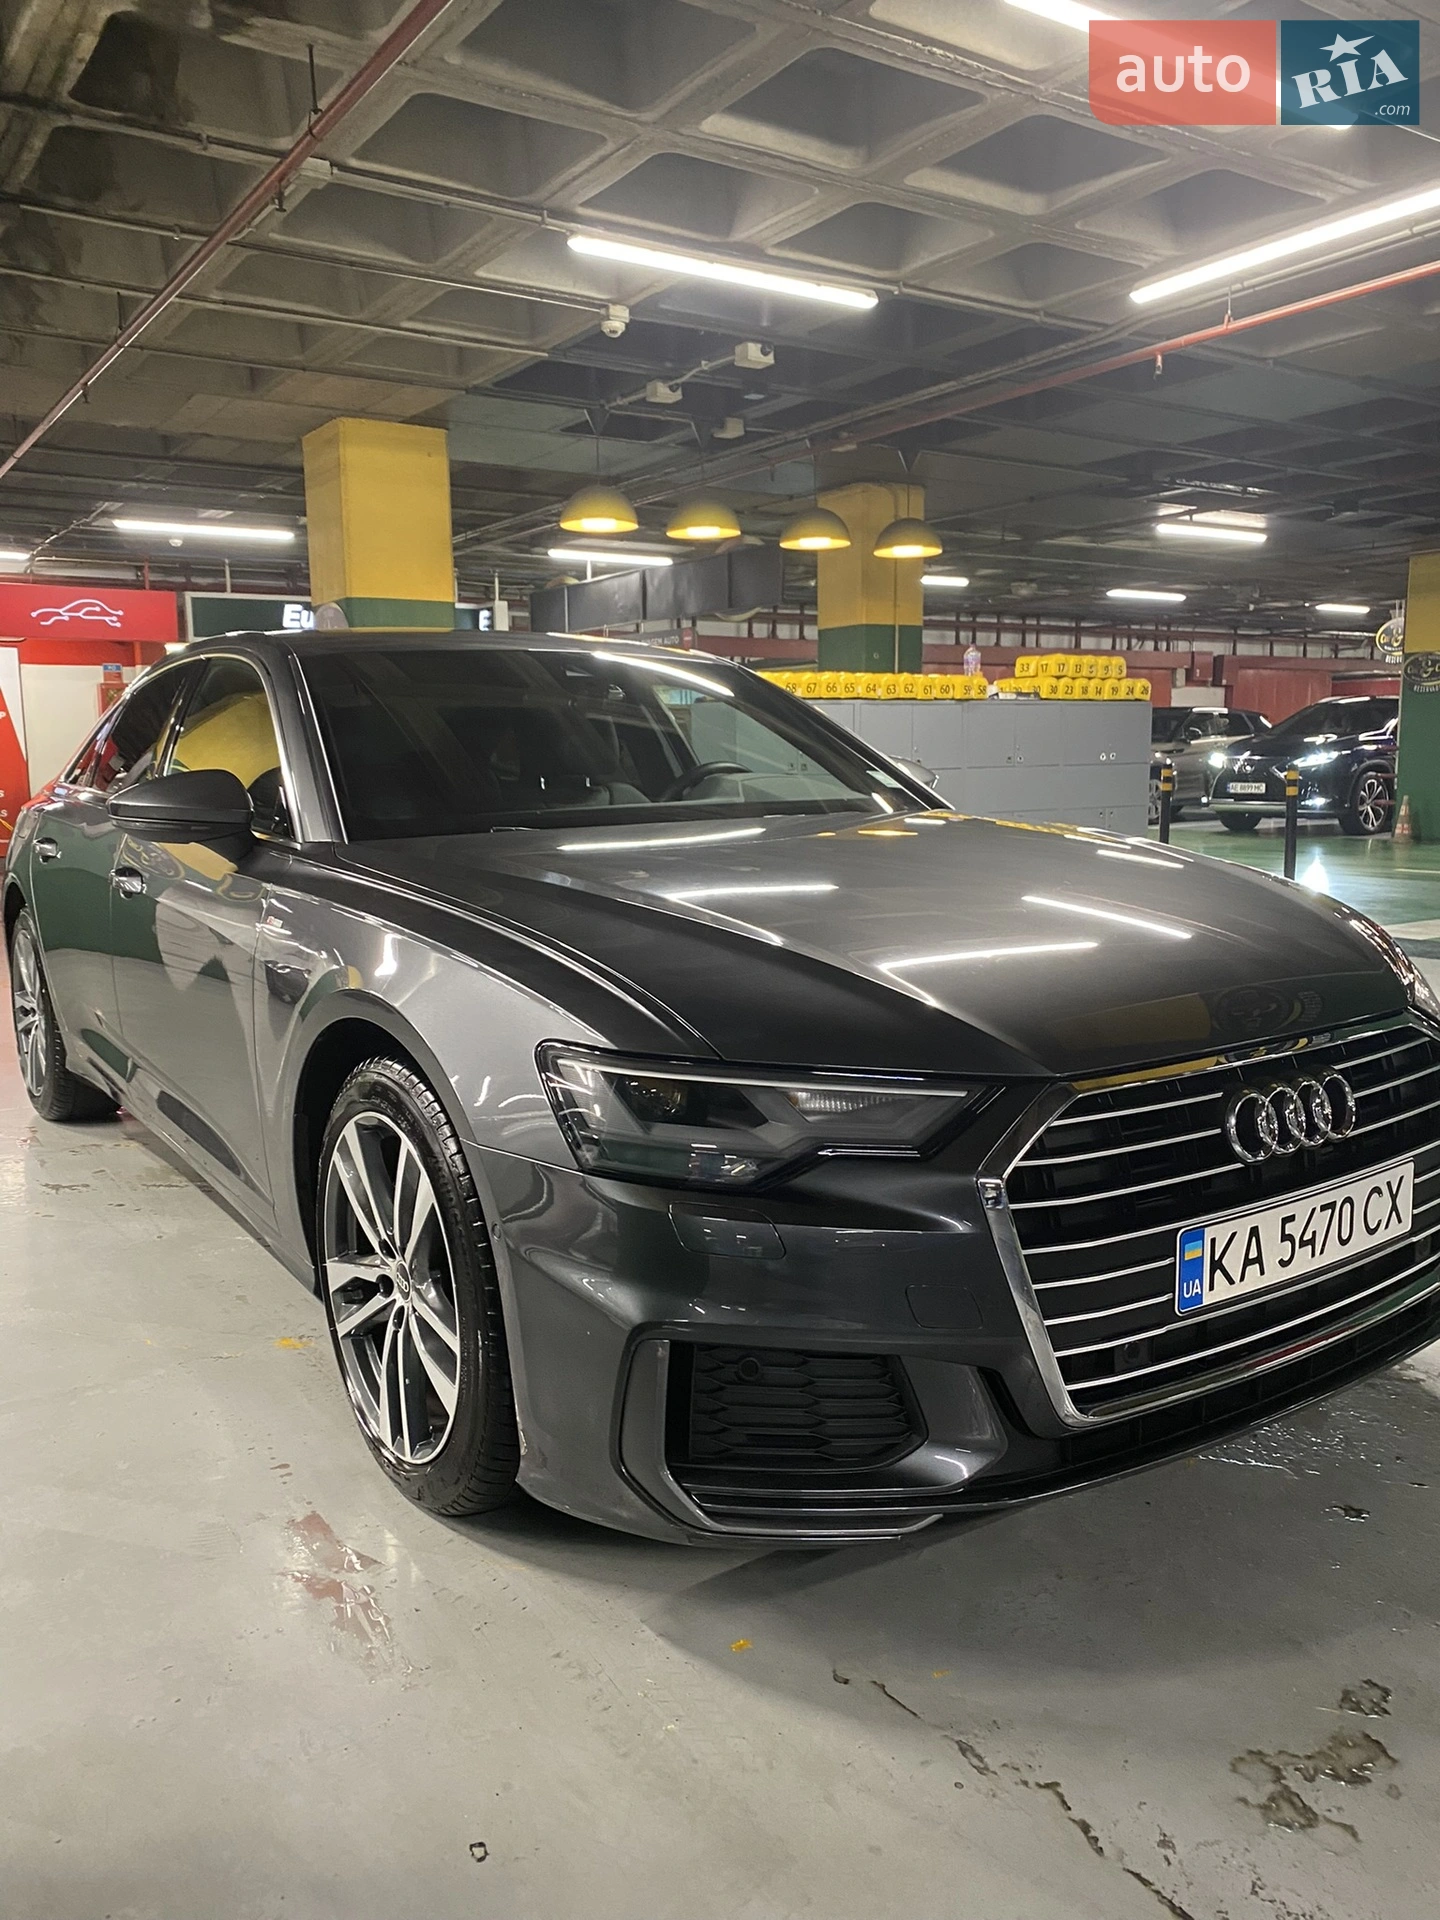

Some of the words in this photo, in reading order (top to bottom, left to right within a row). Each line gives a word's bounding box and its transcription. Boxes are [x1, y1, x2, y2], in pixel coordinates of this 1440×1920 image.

[1019, 663, 1030, 673] 33
[1041, 662, 1049, 673] 17
[1058, 662, 1066, 673] 17
[806, 682, 817, 694] 67
[826, 682, 838, 693] 66
[844, 682, 855, 693] 65
[865, 683, 877, 694] 64
[886, 683, 897, 695] 63
[904, 683, 914, 694] 62
[923, 684, 932, 695] 61
[940, 684, 951, 694] 60
[963, 684, 972, 695] 59
[978, 684, 987, 695] 58
[1049, 685, 1058, 695] 30
[1064, 685, 1074, 695] 23
[1126, 686, 1135, 696] 24
[1141, 686, 1149, 695] 26
[1208, 1225, 1265, 1292] KA
[1277, 1196, 1355, 1268] 5470
[1363, 1175, 1405, 1236] CX
[1183, 1278, 1201, 1299] UA
